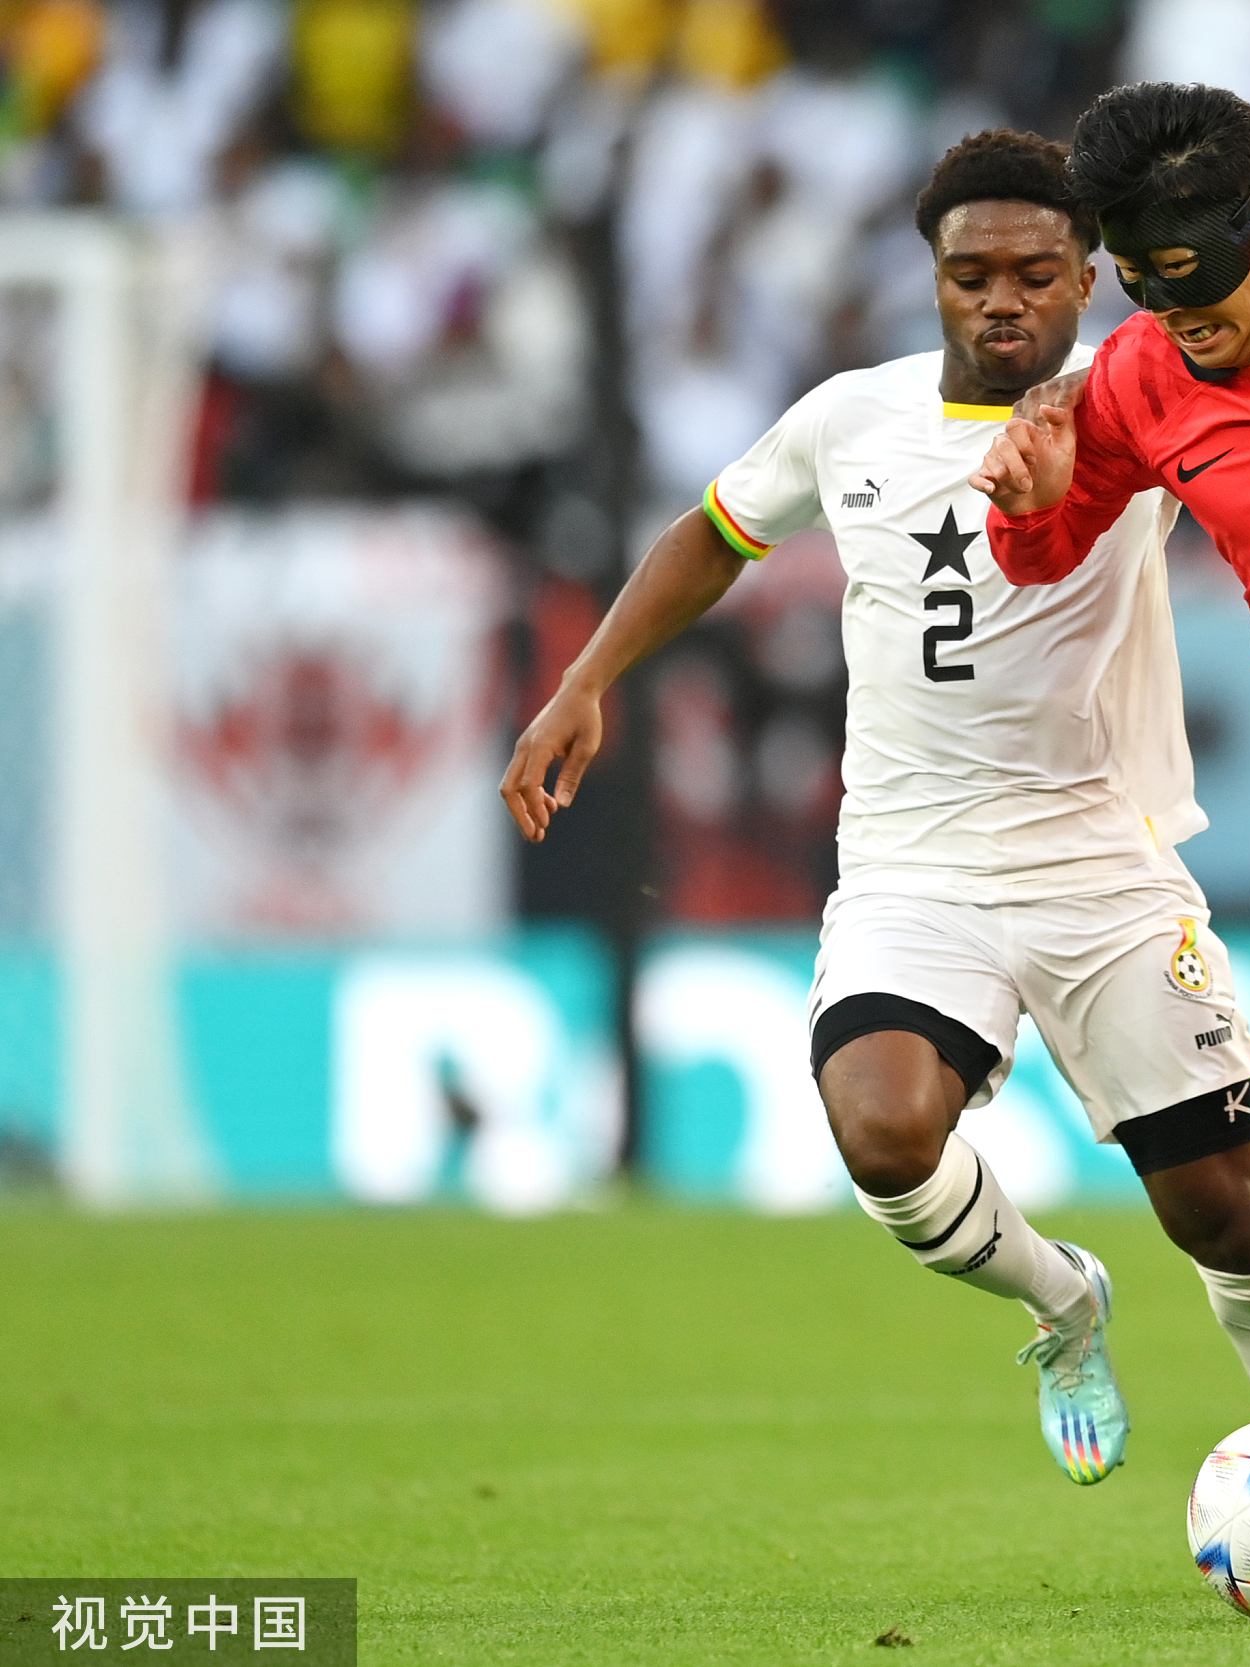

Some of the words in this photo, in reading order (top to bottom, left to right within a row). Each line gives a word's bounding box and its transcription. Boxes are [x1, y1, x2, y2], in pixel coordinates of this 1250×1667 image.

[841, 493, 875, 508] PUMA
[923, 589, 975, 683] 2
[1195, 1026, 1233, 1050] PUMA
